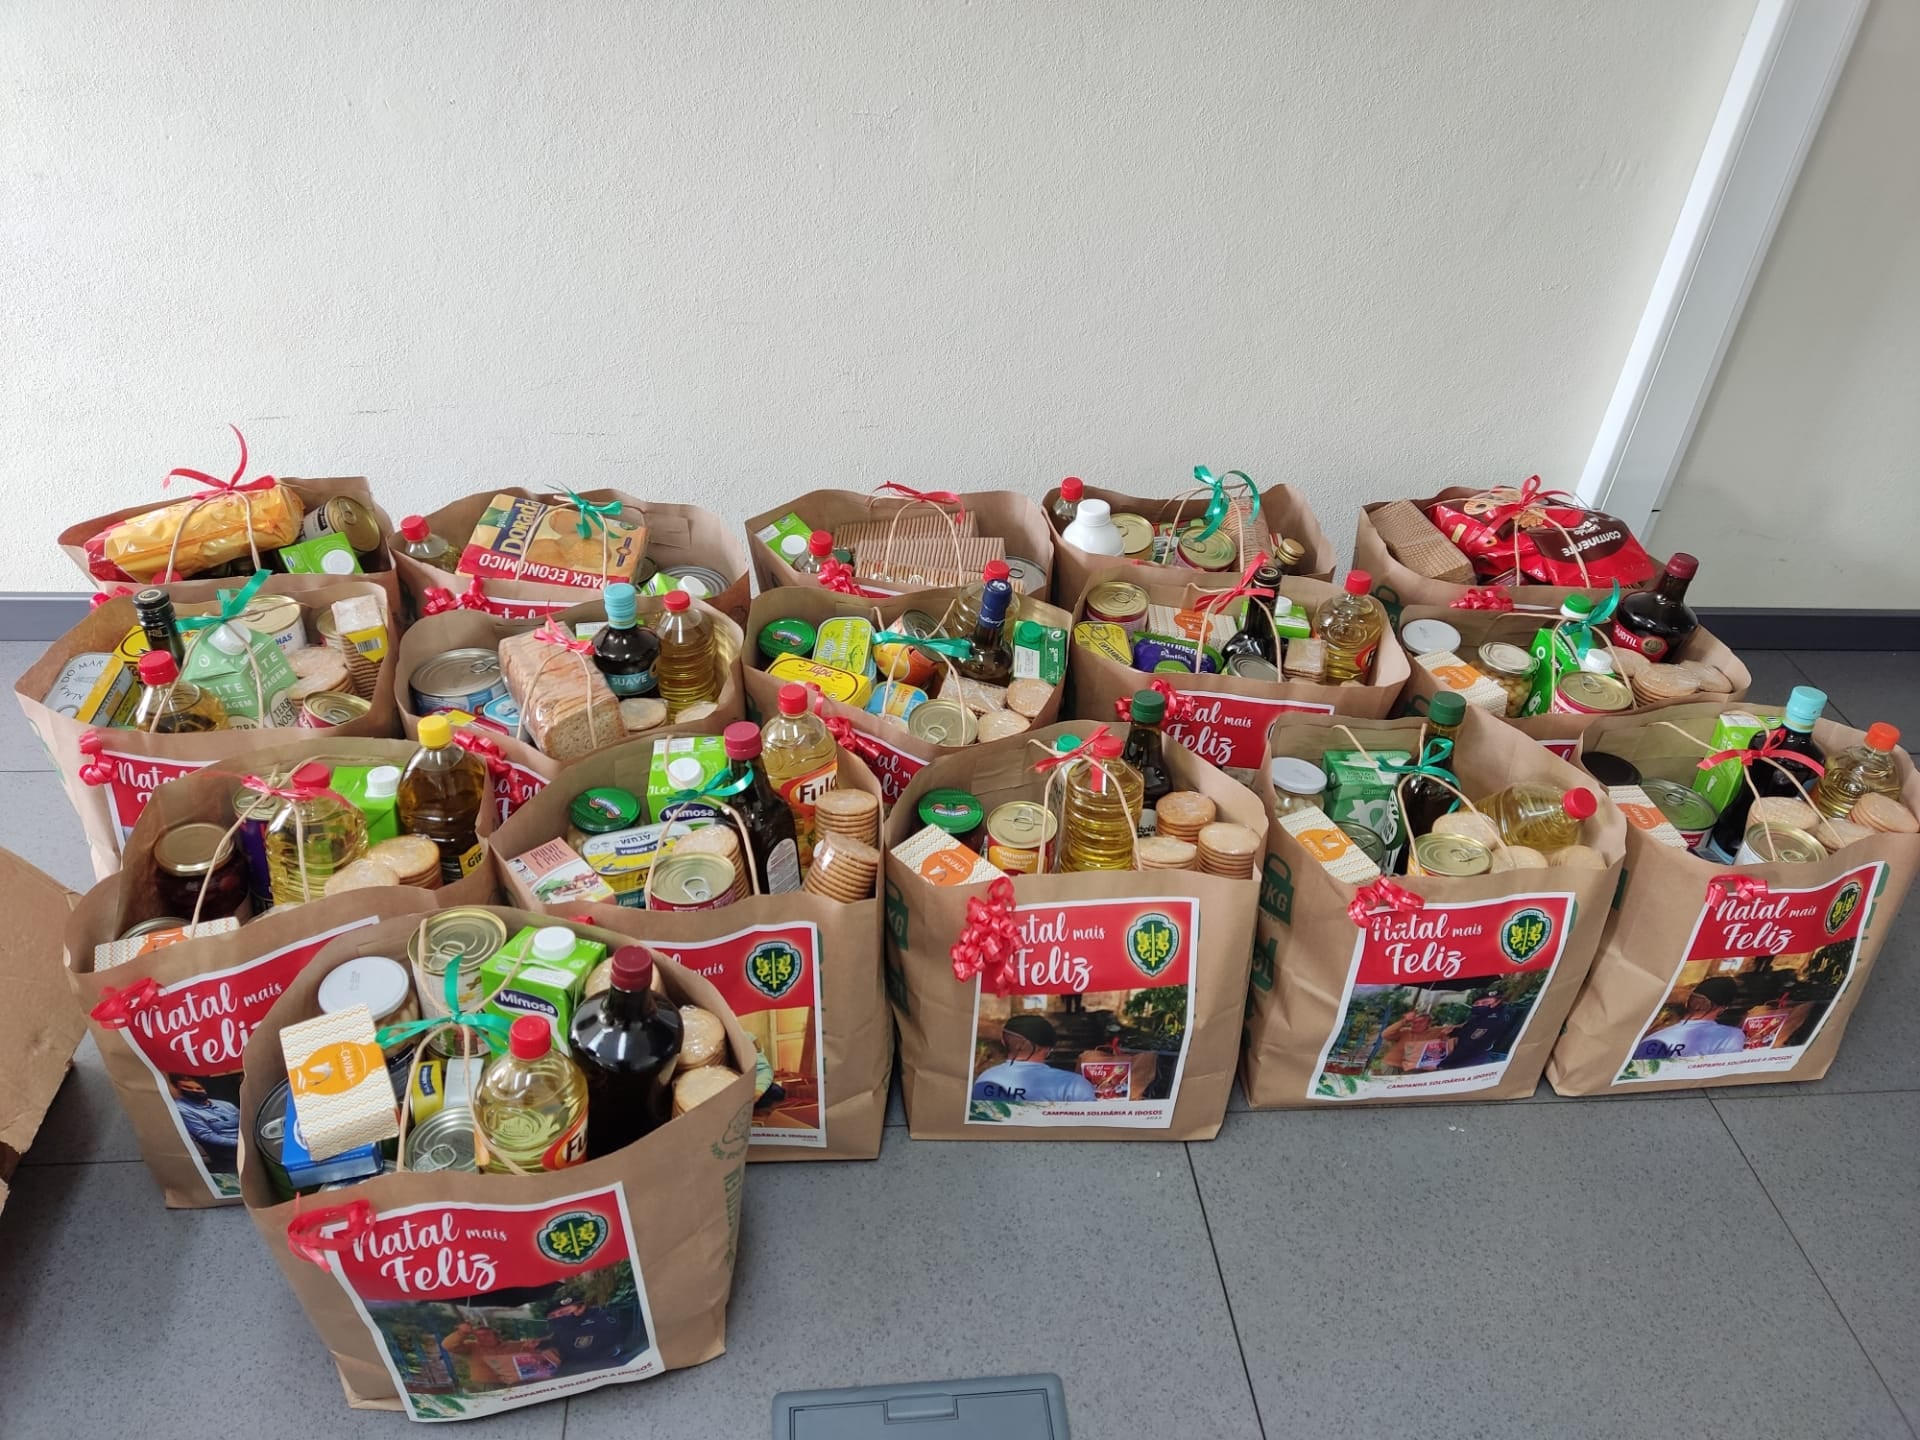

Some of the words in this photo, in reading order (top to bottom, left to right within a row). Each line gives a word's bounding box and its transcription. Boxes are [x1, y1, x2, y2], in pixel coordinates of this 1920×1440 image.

[611, 673, 649, 687] SUAVE
[1224, 716, 1253, 729] mais
[1166, 723, 1237, 765] Feliz
[801, 774, 838, 804] Fula
[665, 808, 715, 820] Mimosa
[941, 855, 966, 873] CAVALA
[1715, 896, 1789, 922] Natal
[1789, 905, 1818, 919] mais
[1018, 912, 1069, 945] atal
[1073, 925, 1106, 941] mais
[1372, 912, 1450, 942] Natal
[1452, 923, 1484, 938] mais
[1723, 922, 1797, 955] Feliz
[1016, 946, 1094, 993] Feliz
[1385, 941, 1467, 978] Feliz
[135, 982, 238, 1039] Natal
[243, 983, 283, 1008] mais
[500, 991, 555, 1015] Mimosa
[170, 1018, 263, 1067] Feli
[1646, 1042, 1685, 1057] GNR
[340, 1050, 356, 1082] CAVALA
[983, 1084, 1027, 1101] GNR
[1135, 1109, 1163, 1117] IDOSOS
[353, 1212, 460, 1263] Natal
[465, 1227, 508, 1243] mais
[380, 1247, 499, 1293] Feliz
[502, 1386, 557, 1402] CAMPANHA
